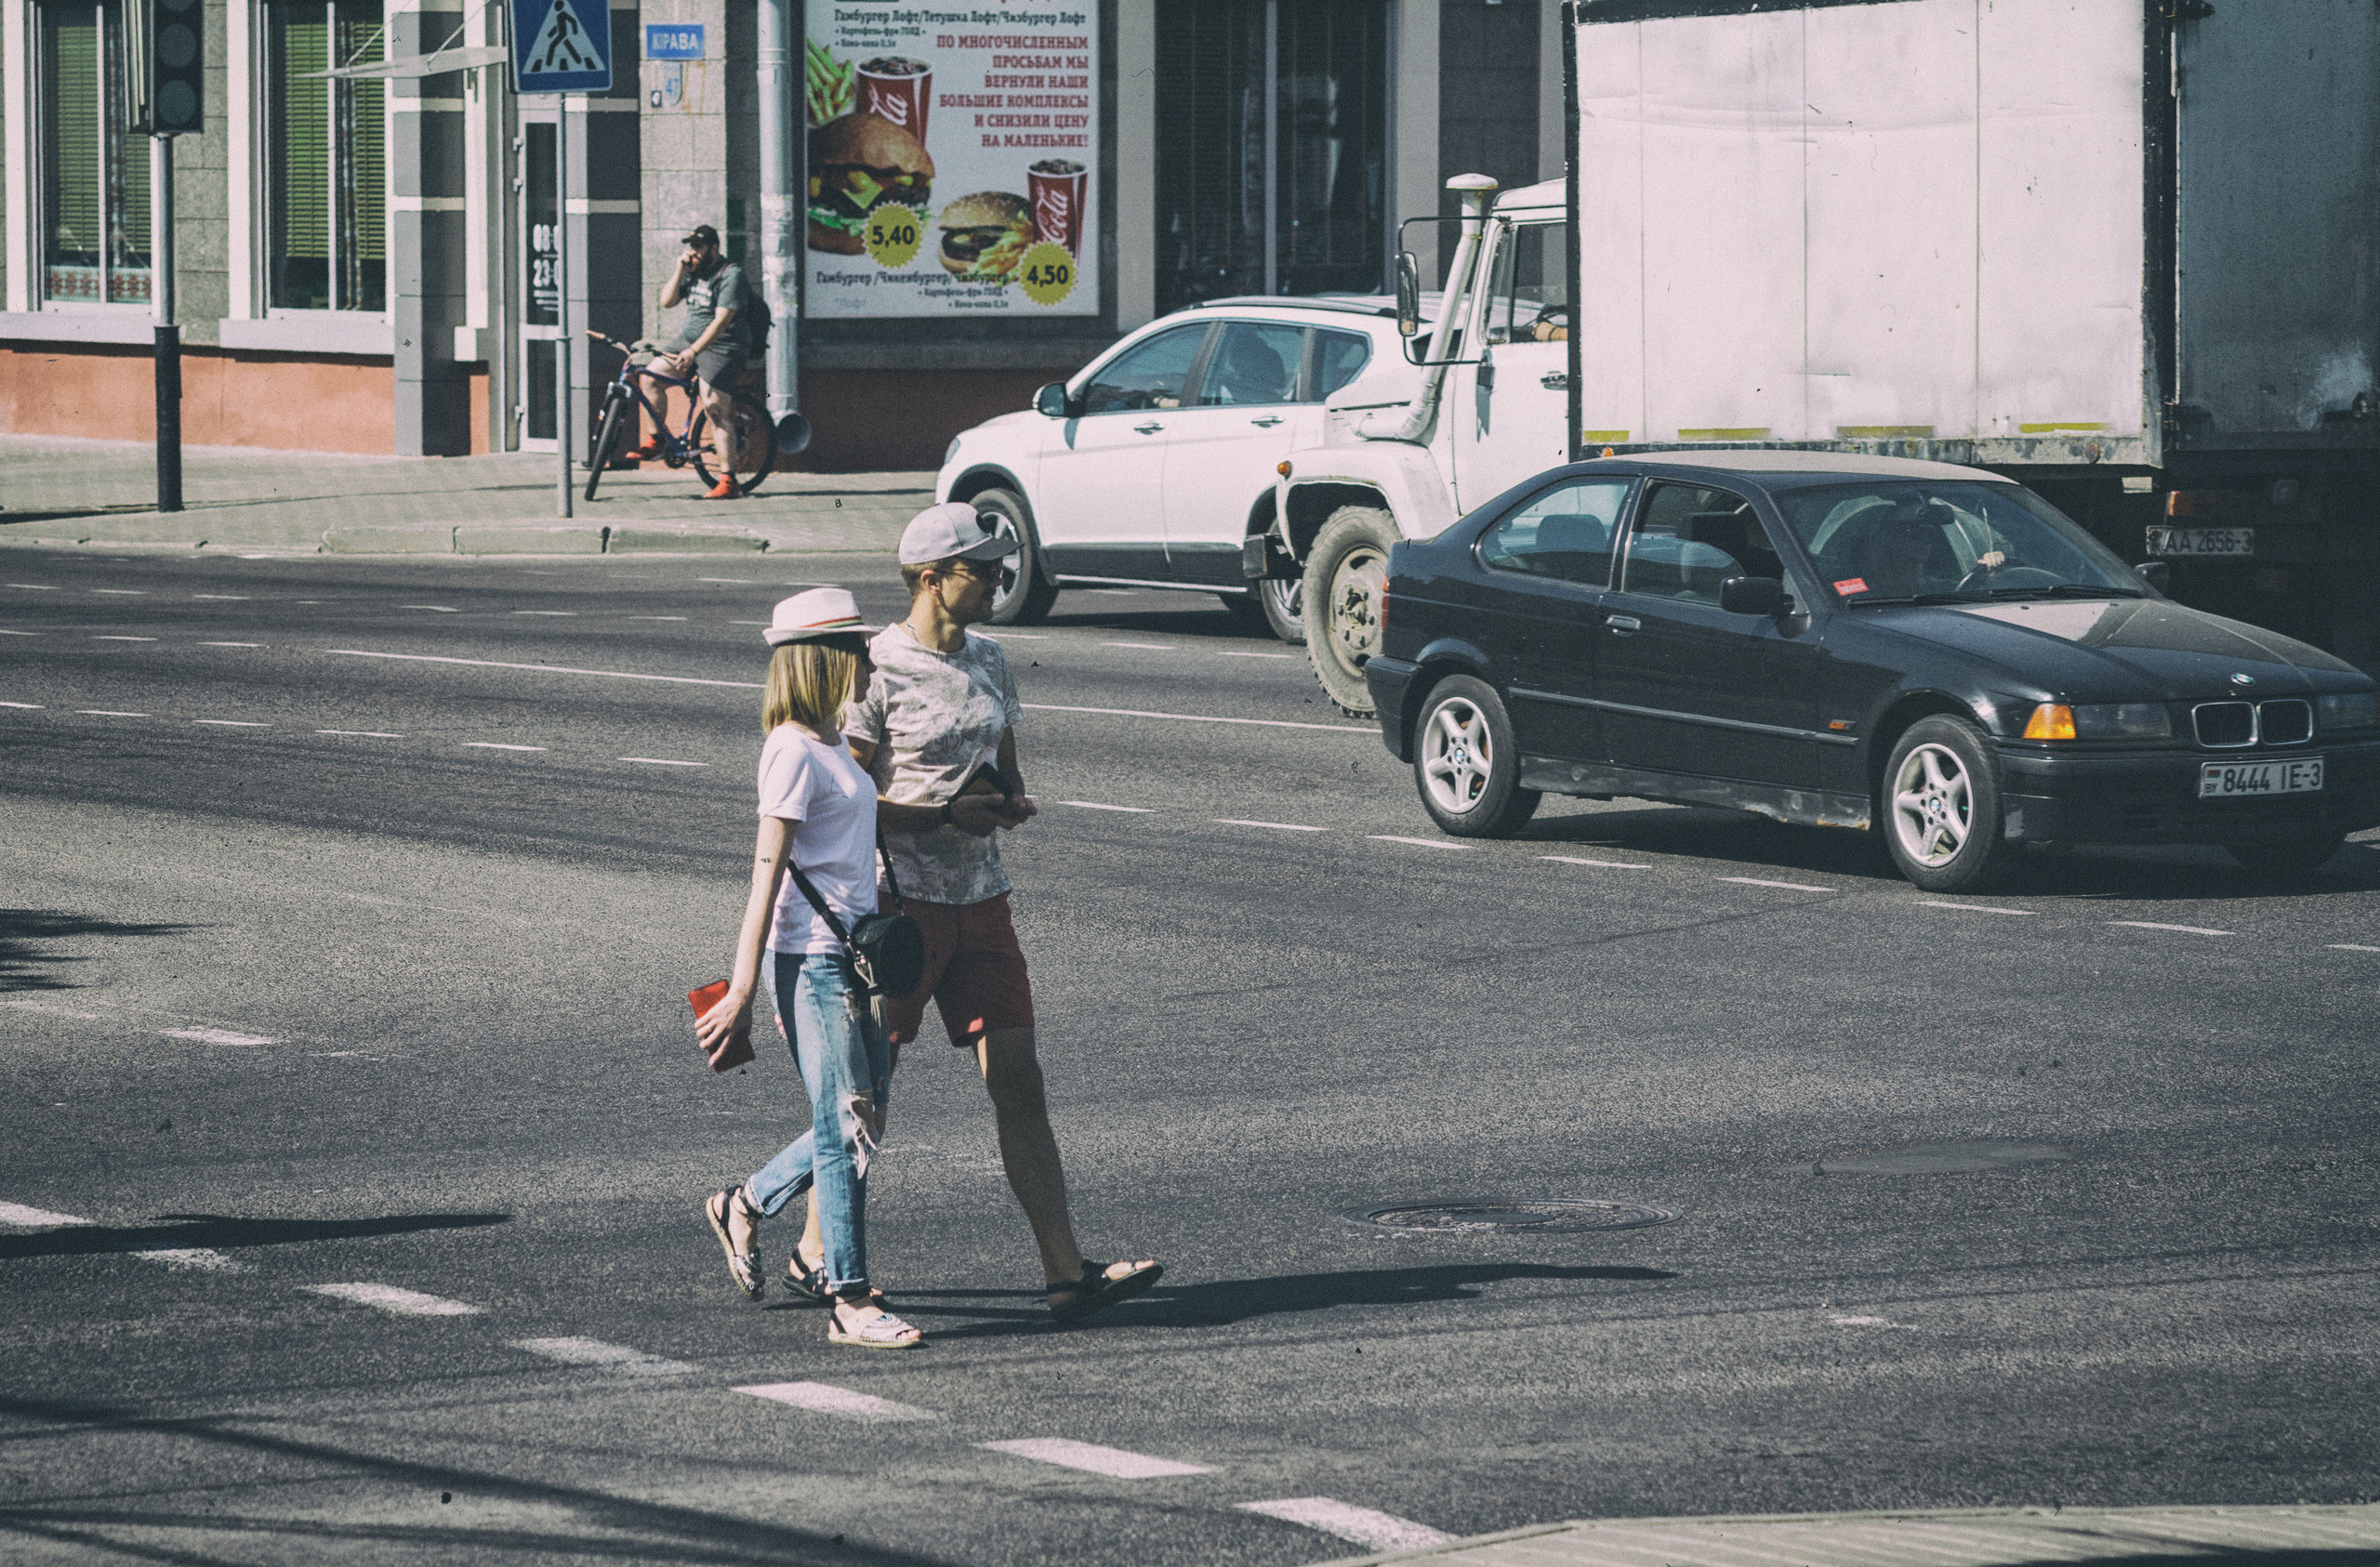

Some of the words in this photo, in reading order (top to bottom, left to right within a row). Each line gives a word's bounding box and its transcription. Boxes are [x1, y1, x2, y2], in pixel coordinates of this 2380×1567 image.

[835, 8, 890, 24] Гамбургер
[937, 35, 955, 48] ПО
[958, 35, 1089, 49] МНОГОЧИСЛЕННЫМ
[993, 55, 1062, 69] ПРОСЬБАМ
[1066, 55, 1089, 69] МЫ
[985, 74, 1045, 88] ВЕРНУЛИ
[1048, 74, 1088, 88] НАШИ
[939, 94, 1003, 108] БОЛЬШИЕ
[1007, 94, 1089, 108] КОМПЛЕКСЫ
[974, 114, 985, 127] И
[987, 114, 1051, 127] СНИЗИЛИ
[1053, 114, 1089, 129] ЦЕНУ
[982, 134, 1000, 147] НА
[1004, 134, 1088, 148] МАЛЕНЬКИЕ!
[872, 225, 915, 248] 5,40
[816, 270, 872, 286] Гамбургер
[1027, 265, 1068, 288] 4,50
[2164, 530, 2191, 552] AA
[2196, 530, 2251, 552] 2656-3
[2223, 766, 2270, 792] 8444
